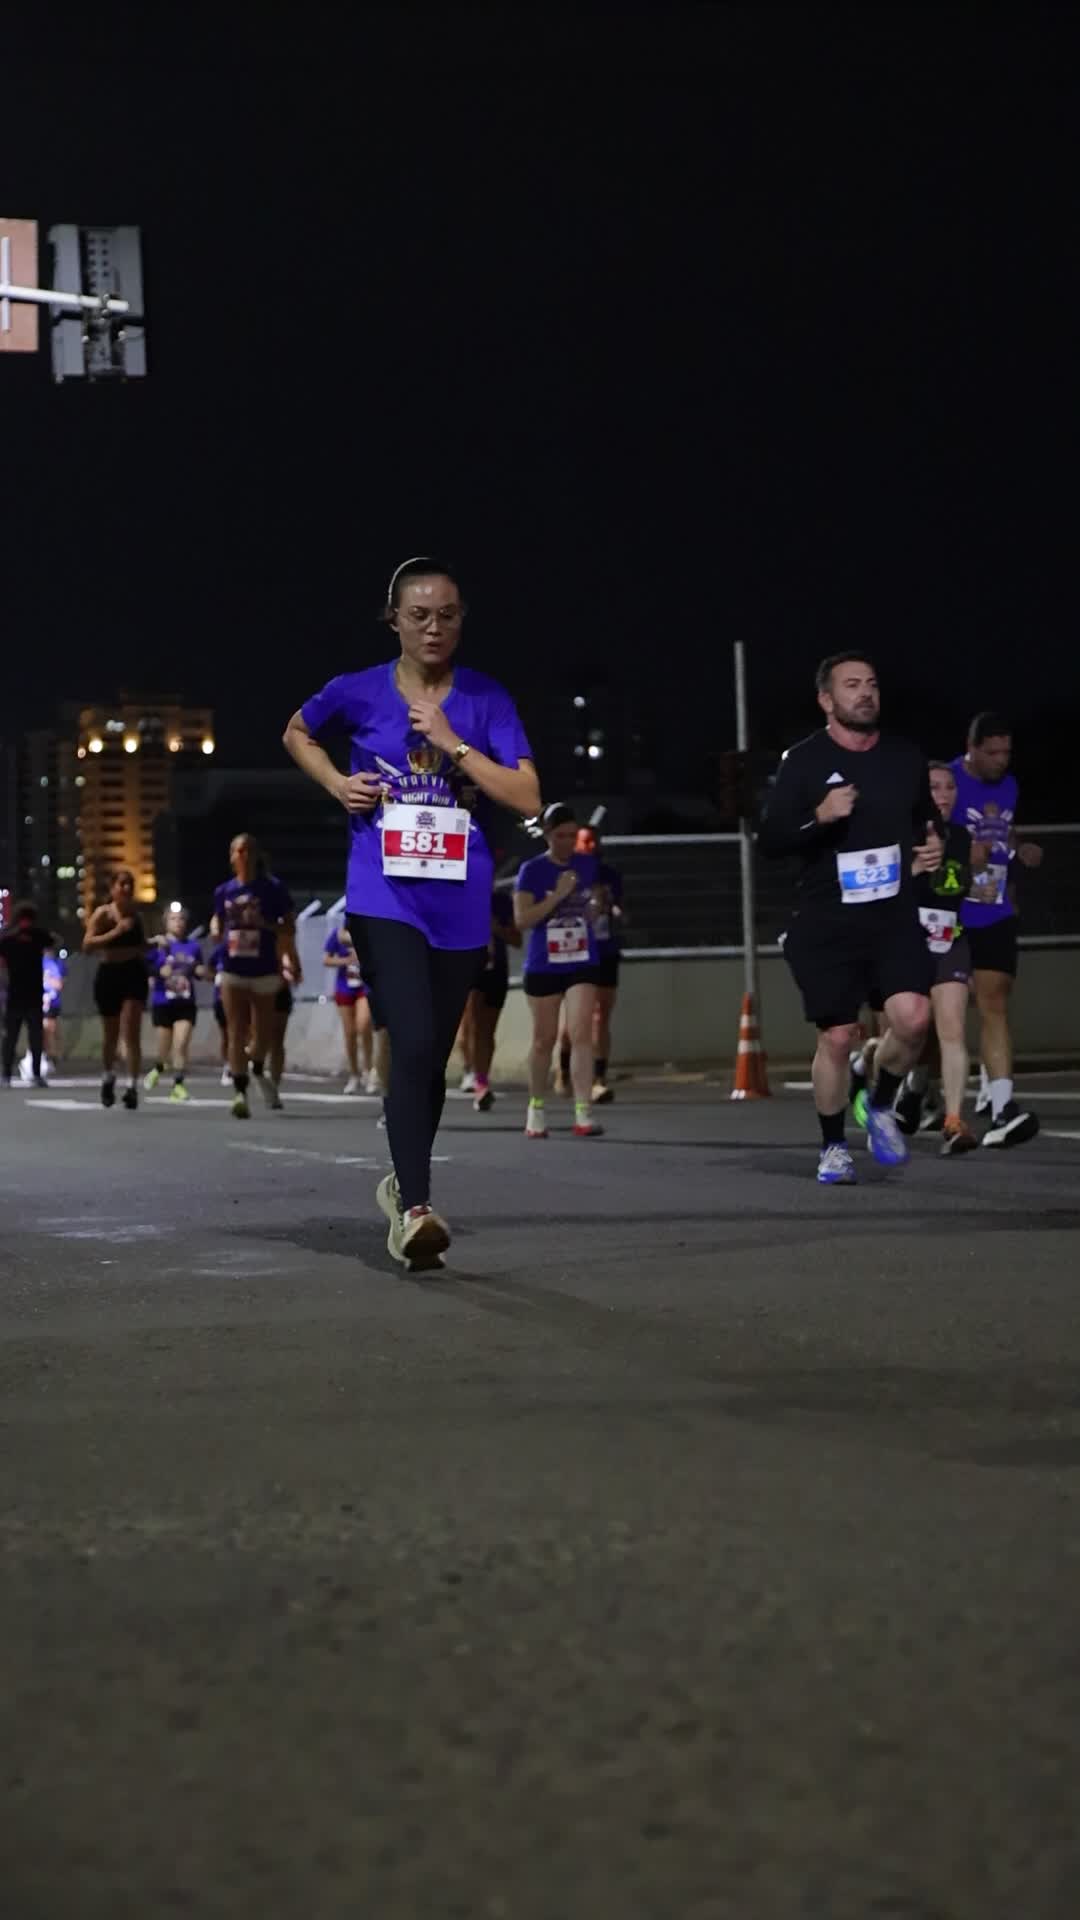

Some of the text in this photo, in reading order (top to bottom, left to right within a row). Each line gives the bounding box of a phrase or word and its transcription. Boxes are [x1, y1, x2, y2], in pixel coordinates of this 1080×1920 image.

[402, 792, 430, 804] NIGHT
[400, 831, 447, 854] 581
[855, 866, 890, 885] 623
